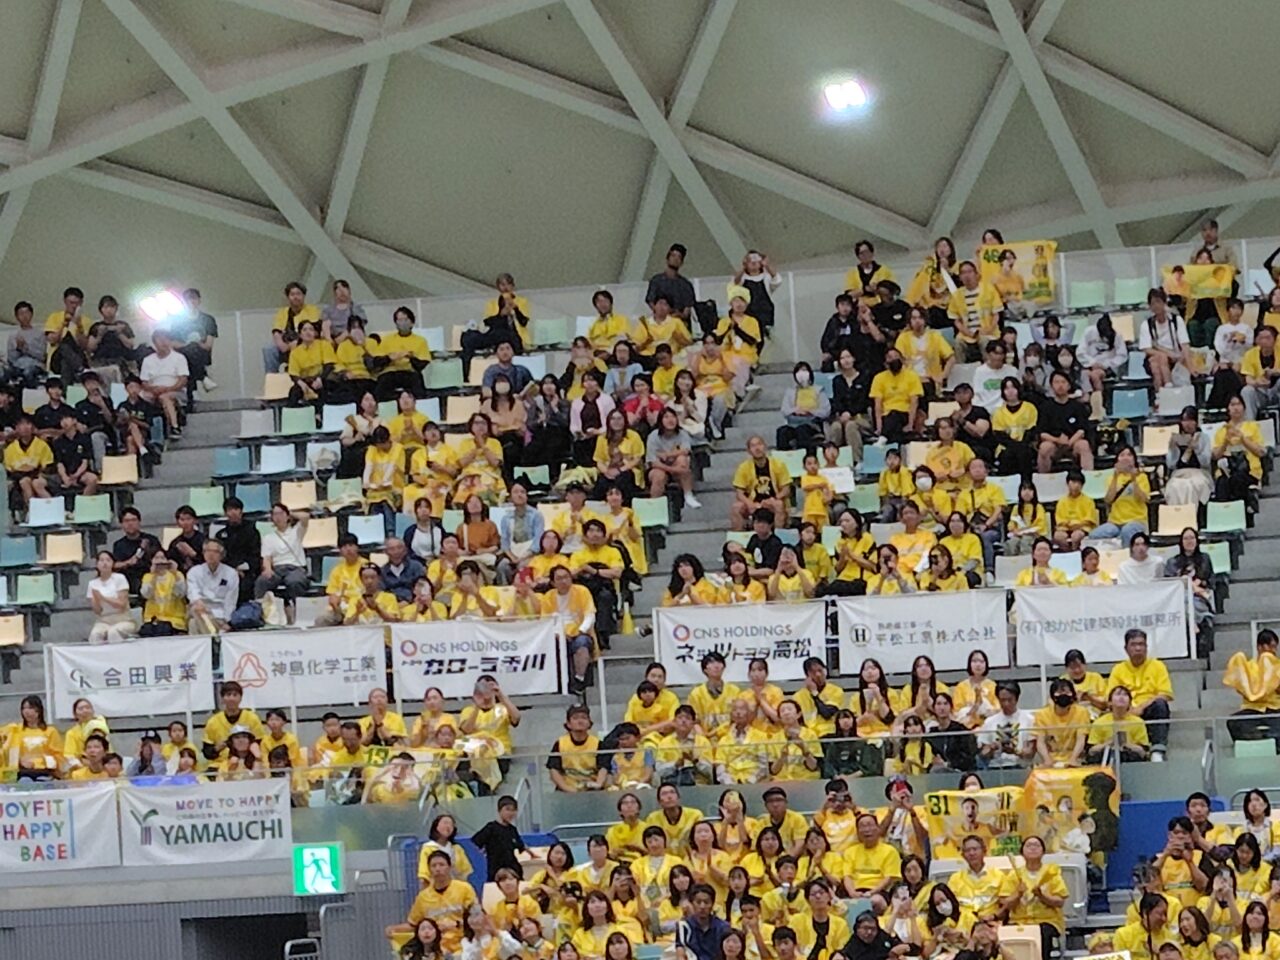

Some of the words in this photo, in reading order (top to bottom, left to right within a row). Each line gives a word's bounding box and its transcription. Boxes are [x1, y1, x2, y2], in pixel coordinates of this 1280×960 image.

[693, 627, 720, 640] CNS
[724, 624, 793, 638] HOLDINGS
[420, 641, 446, 653] CNS
[451, 640, 518, 653] HOLDINGS
[104, 662, 197, 687] 合田興業
[271, 655, 377, 677] 神島化学工業
[176, 798, 213, 811] MOVE
[218, 797, 235, 808] TO
[239, 794, 281, 807] HAPPY
[928, 795, 951, 816] 31
[2, 821, 65, 841] HAPPY
[160, 818, 284, 846] YAMAUCHI
[20, 843, 68, 862] BASE
